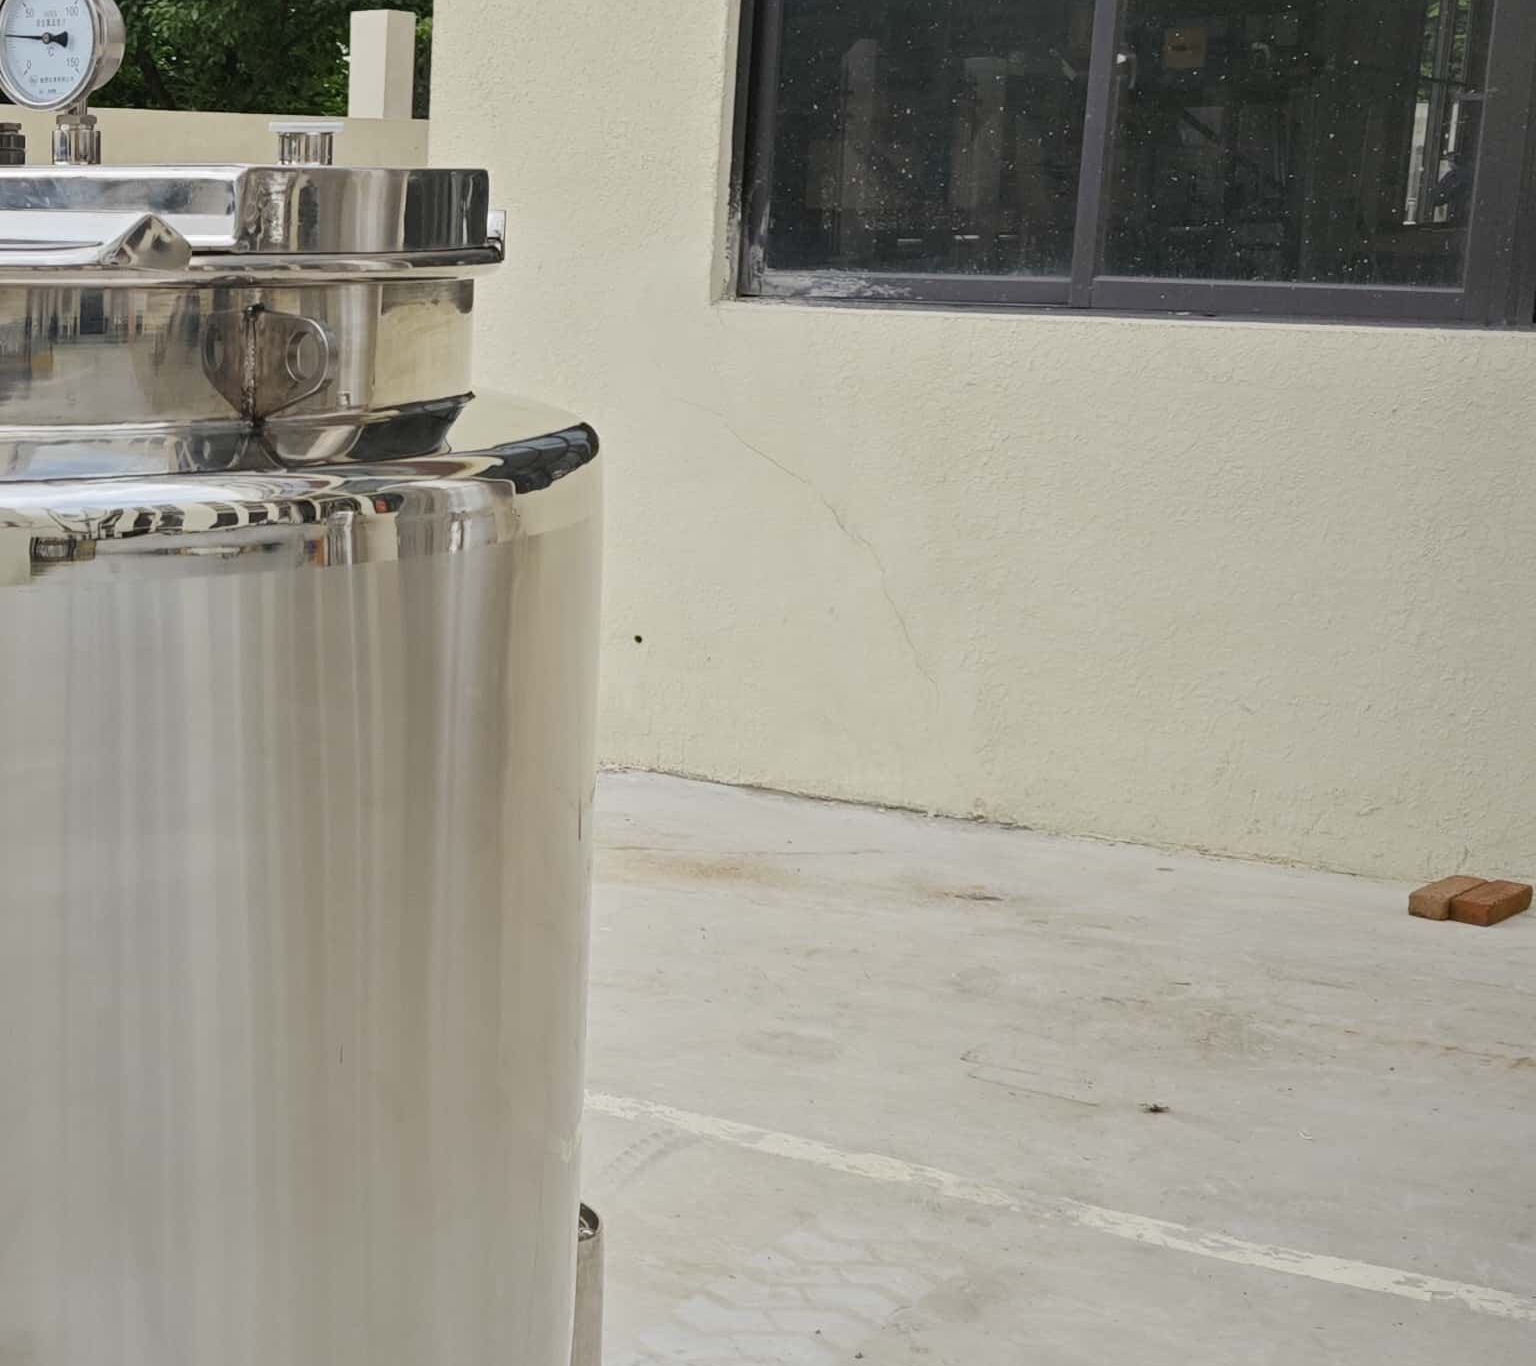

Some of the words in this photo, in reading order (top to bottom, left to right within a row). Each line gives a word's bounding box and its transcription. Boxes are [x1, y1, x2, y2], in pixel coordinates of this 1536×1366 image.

[25, 7, 34, 18] 50
[65, 6, 79, 17] 100
[26, 59, 32, 70] 0
[66, 57, 80, 68] 150
